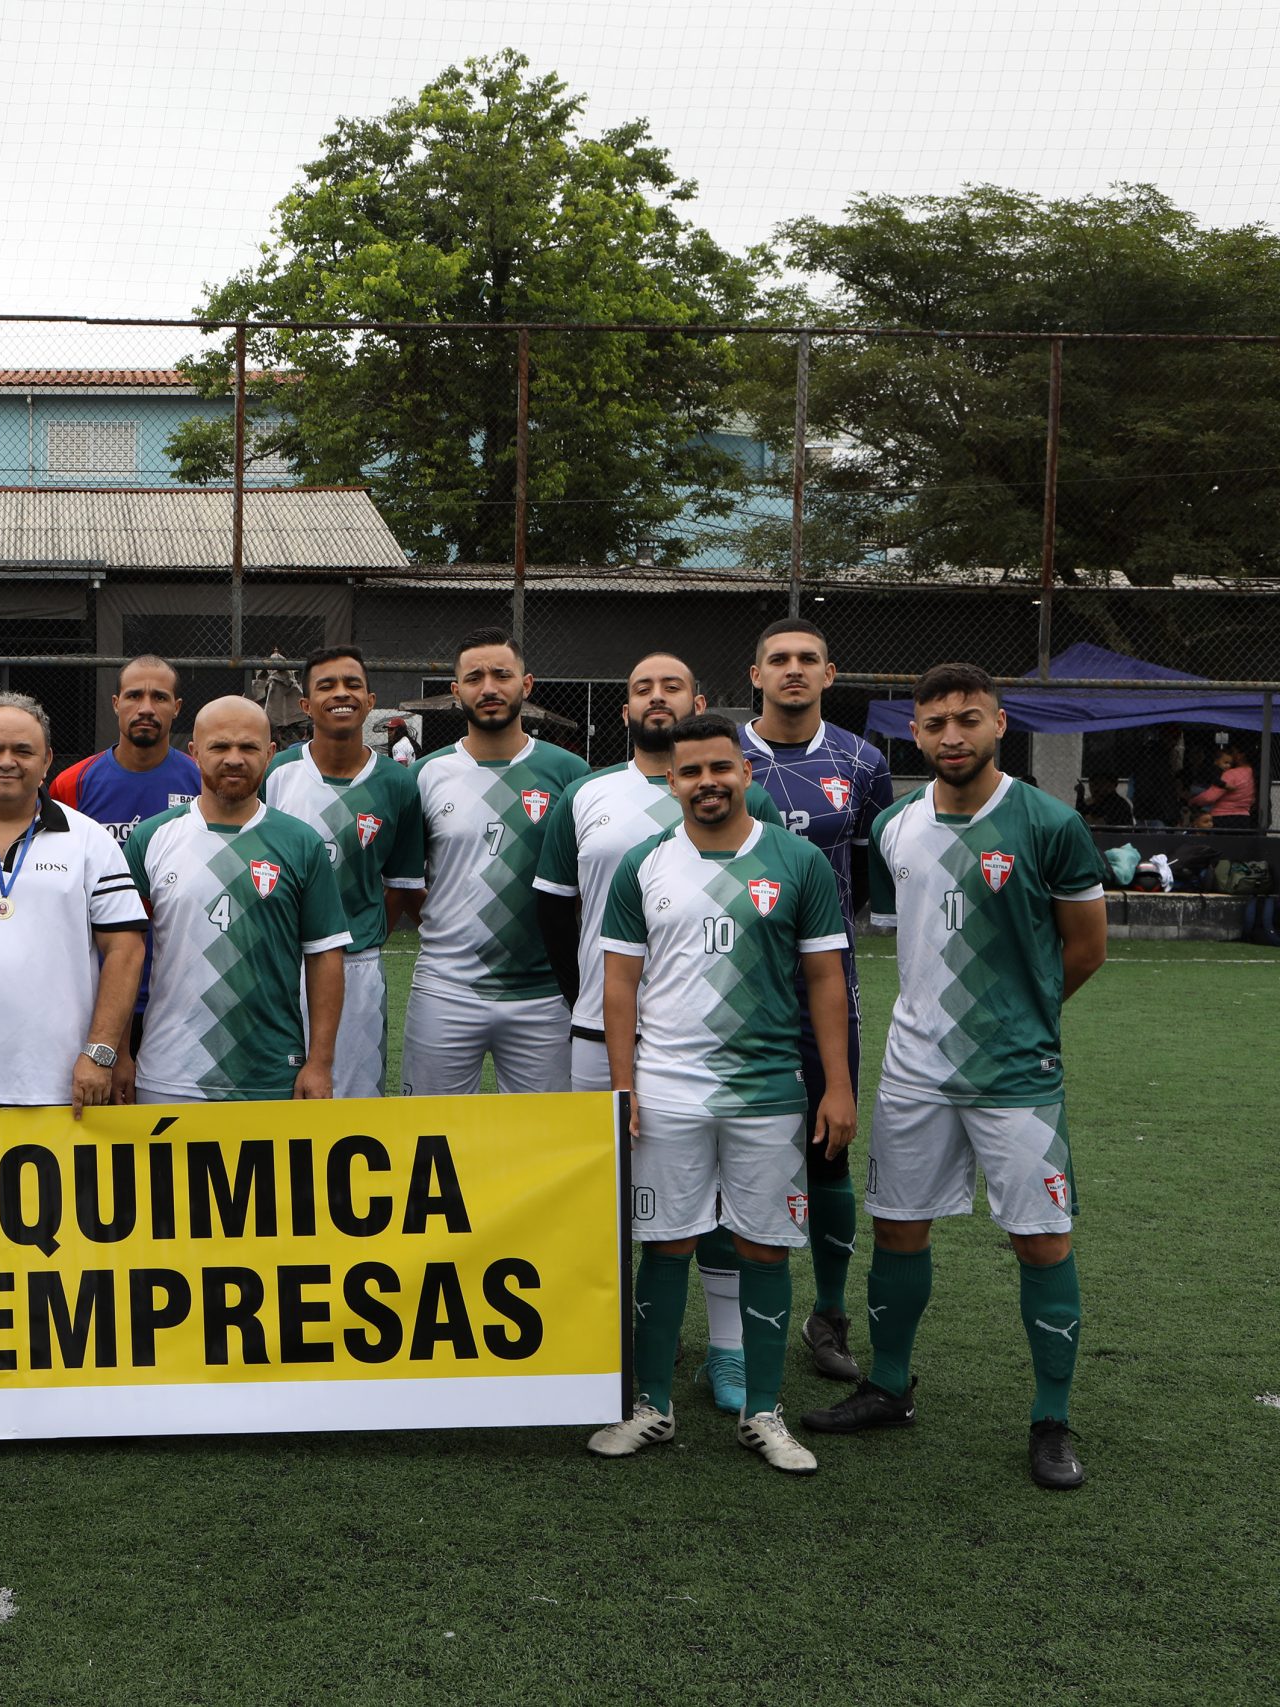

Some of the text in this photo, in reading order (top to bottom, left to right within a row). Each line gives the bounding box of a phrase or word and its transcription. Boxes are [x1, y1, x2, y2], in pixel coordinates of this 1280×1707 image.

[487, 822, 505, 856] 7
[35, 863, 68, 872] BOSS
[984, 862, 1009, 870] PALESTRA
[208, 893, 231, 932] 4
[944, 890, 965, 931] 11
[703, 916, 735, 954] 10
